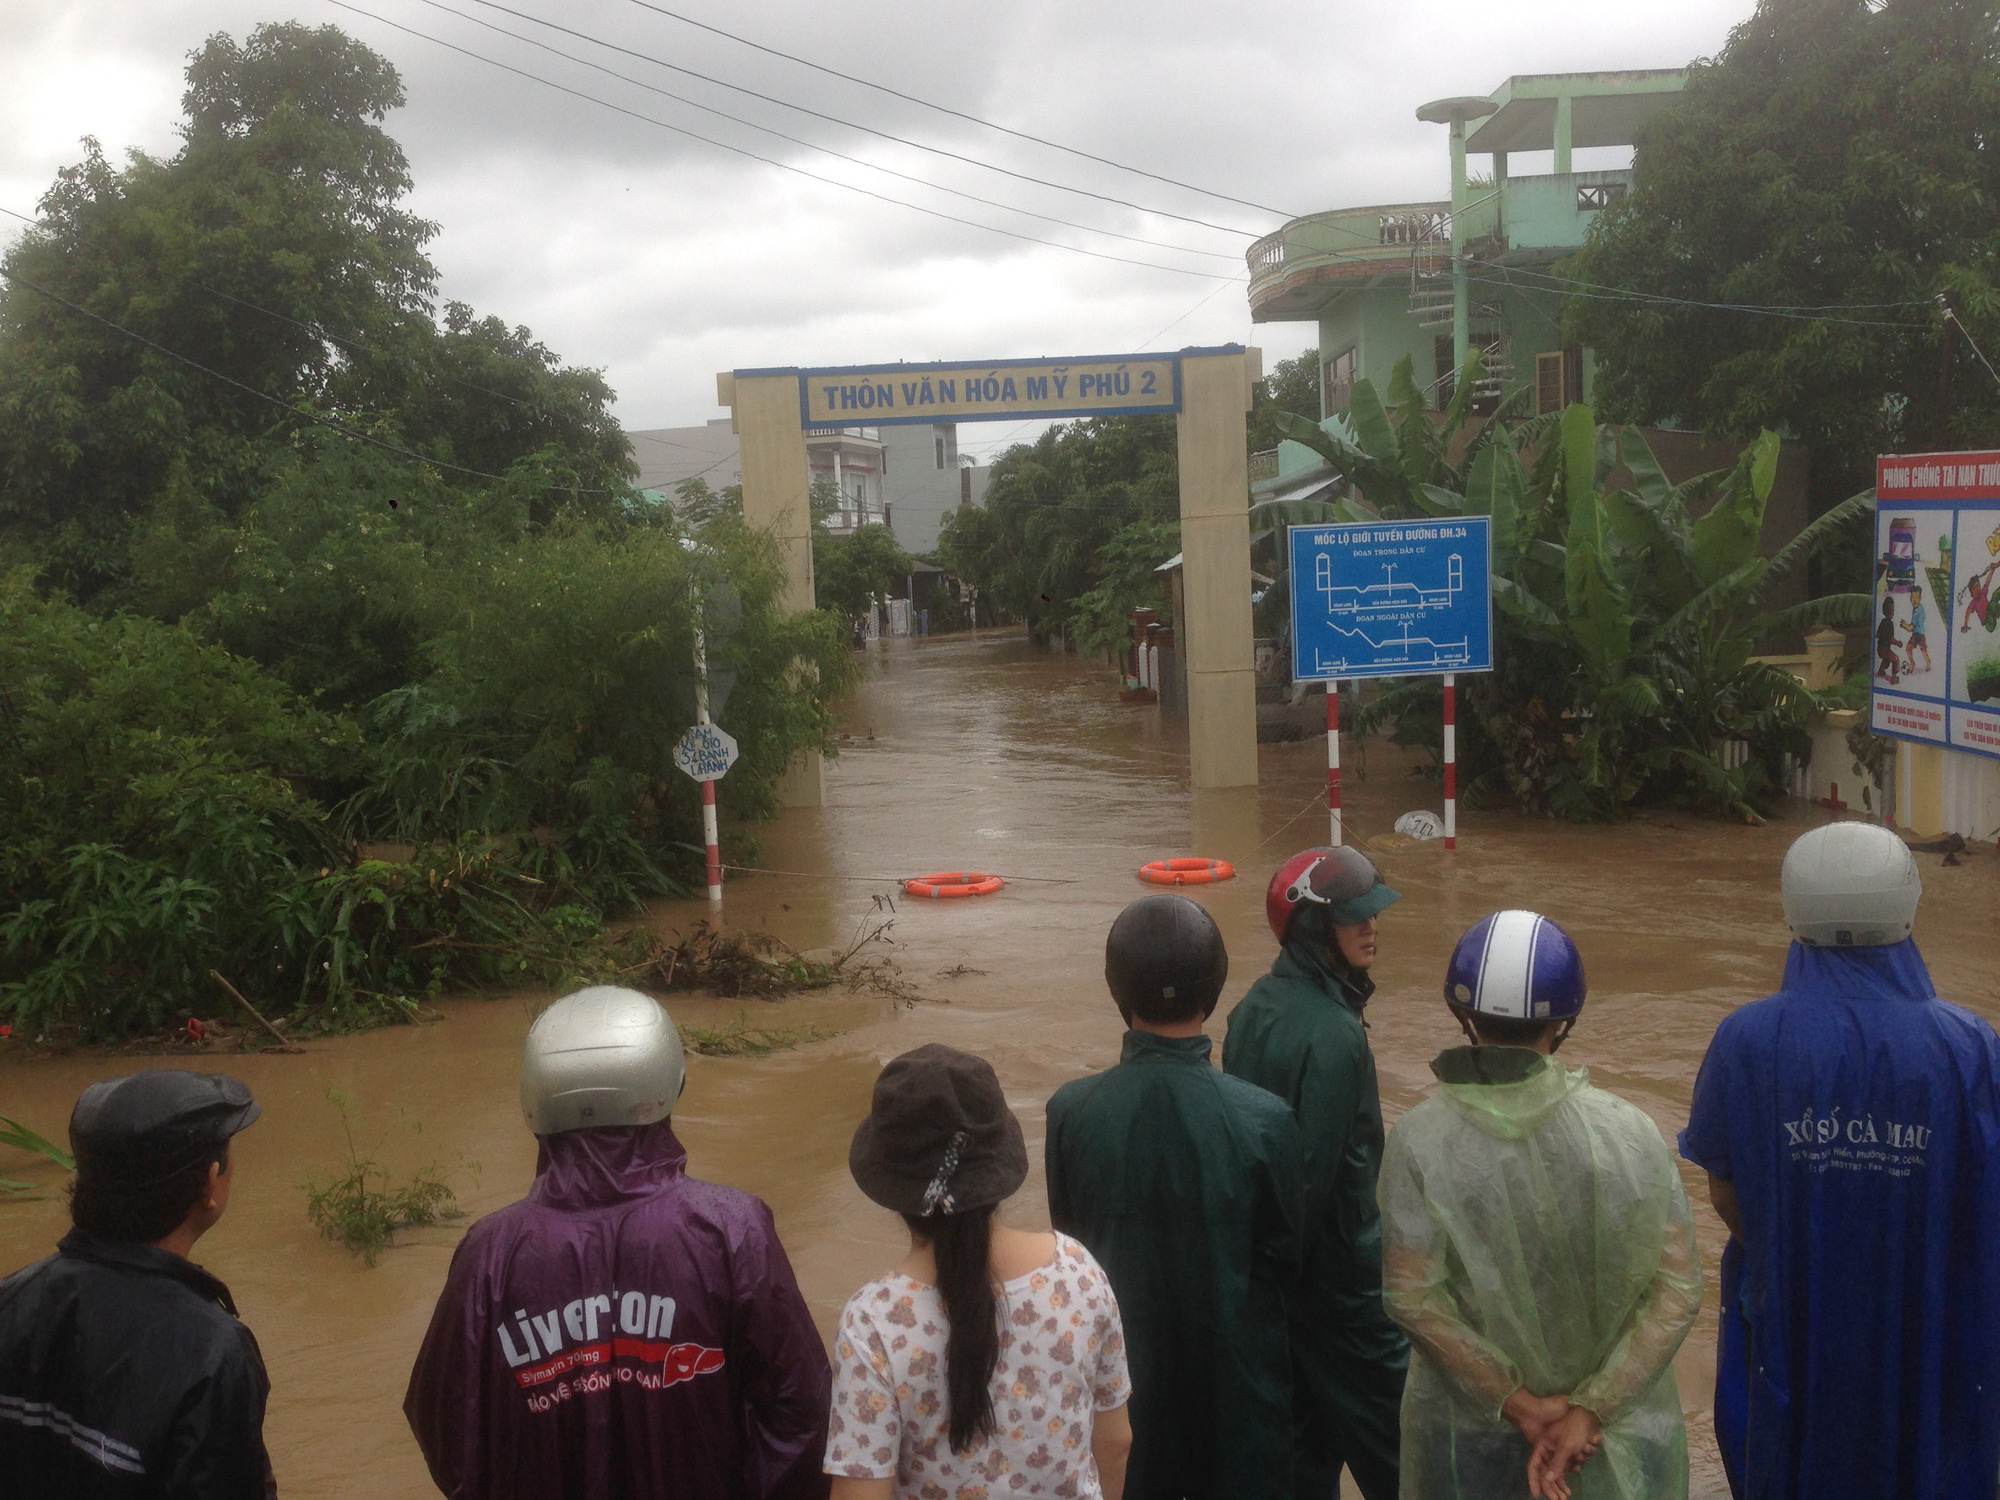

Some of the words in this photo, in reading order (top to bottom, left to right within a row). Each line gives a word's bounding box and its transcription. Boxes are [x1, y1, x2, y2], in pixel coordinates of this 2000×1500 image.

[823, 378, 893, 410] THÔN
[902, 377, 956, 406] VĂN
[966, 371, 1017, 403] HÓA
[1027, 367, 1068, 400] MỸ
[1079, 365, 1130, 397] PHÚ
[1141, 371, 1157, 395] 2
[1883, 465, 1909, 489] PHÒNG
[1912, 461, 1940, 488] CHỐNG
[1943, 465, 1956, 486] TAI
[1958, 464, 1976, 491] NẠN
[1314, 532, 1335, 546] MỐC
[1338, 532, 1349, 546] LỘ
[1352, 531, 1371, 544] GIỚI
[1374, 528, 1403, 542] TUYẾN
[1405, 529, 1437, 541] ĐƯỜNG
[1784, 1107, 1813, 1145] XỔ
[1817, 1106, 1840, 1144] SỐ
[1847, 1113, 1879, 1143] CÀ
[1886, 1121, 1932, 1150] MAU
[497, 1290, 676, 1368] Liveron
